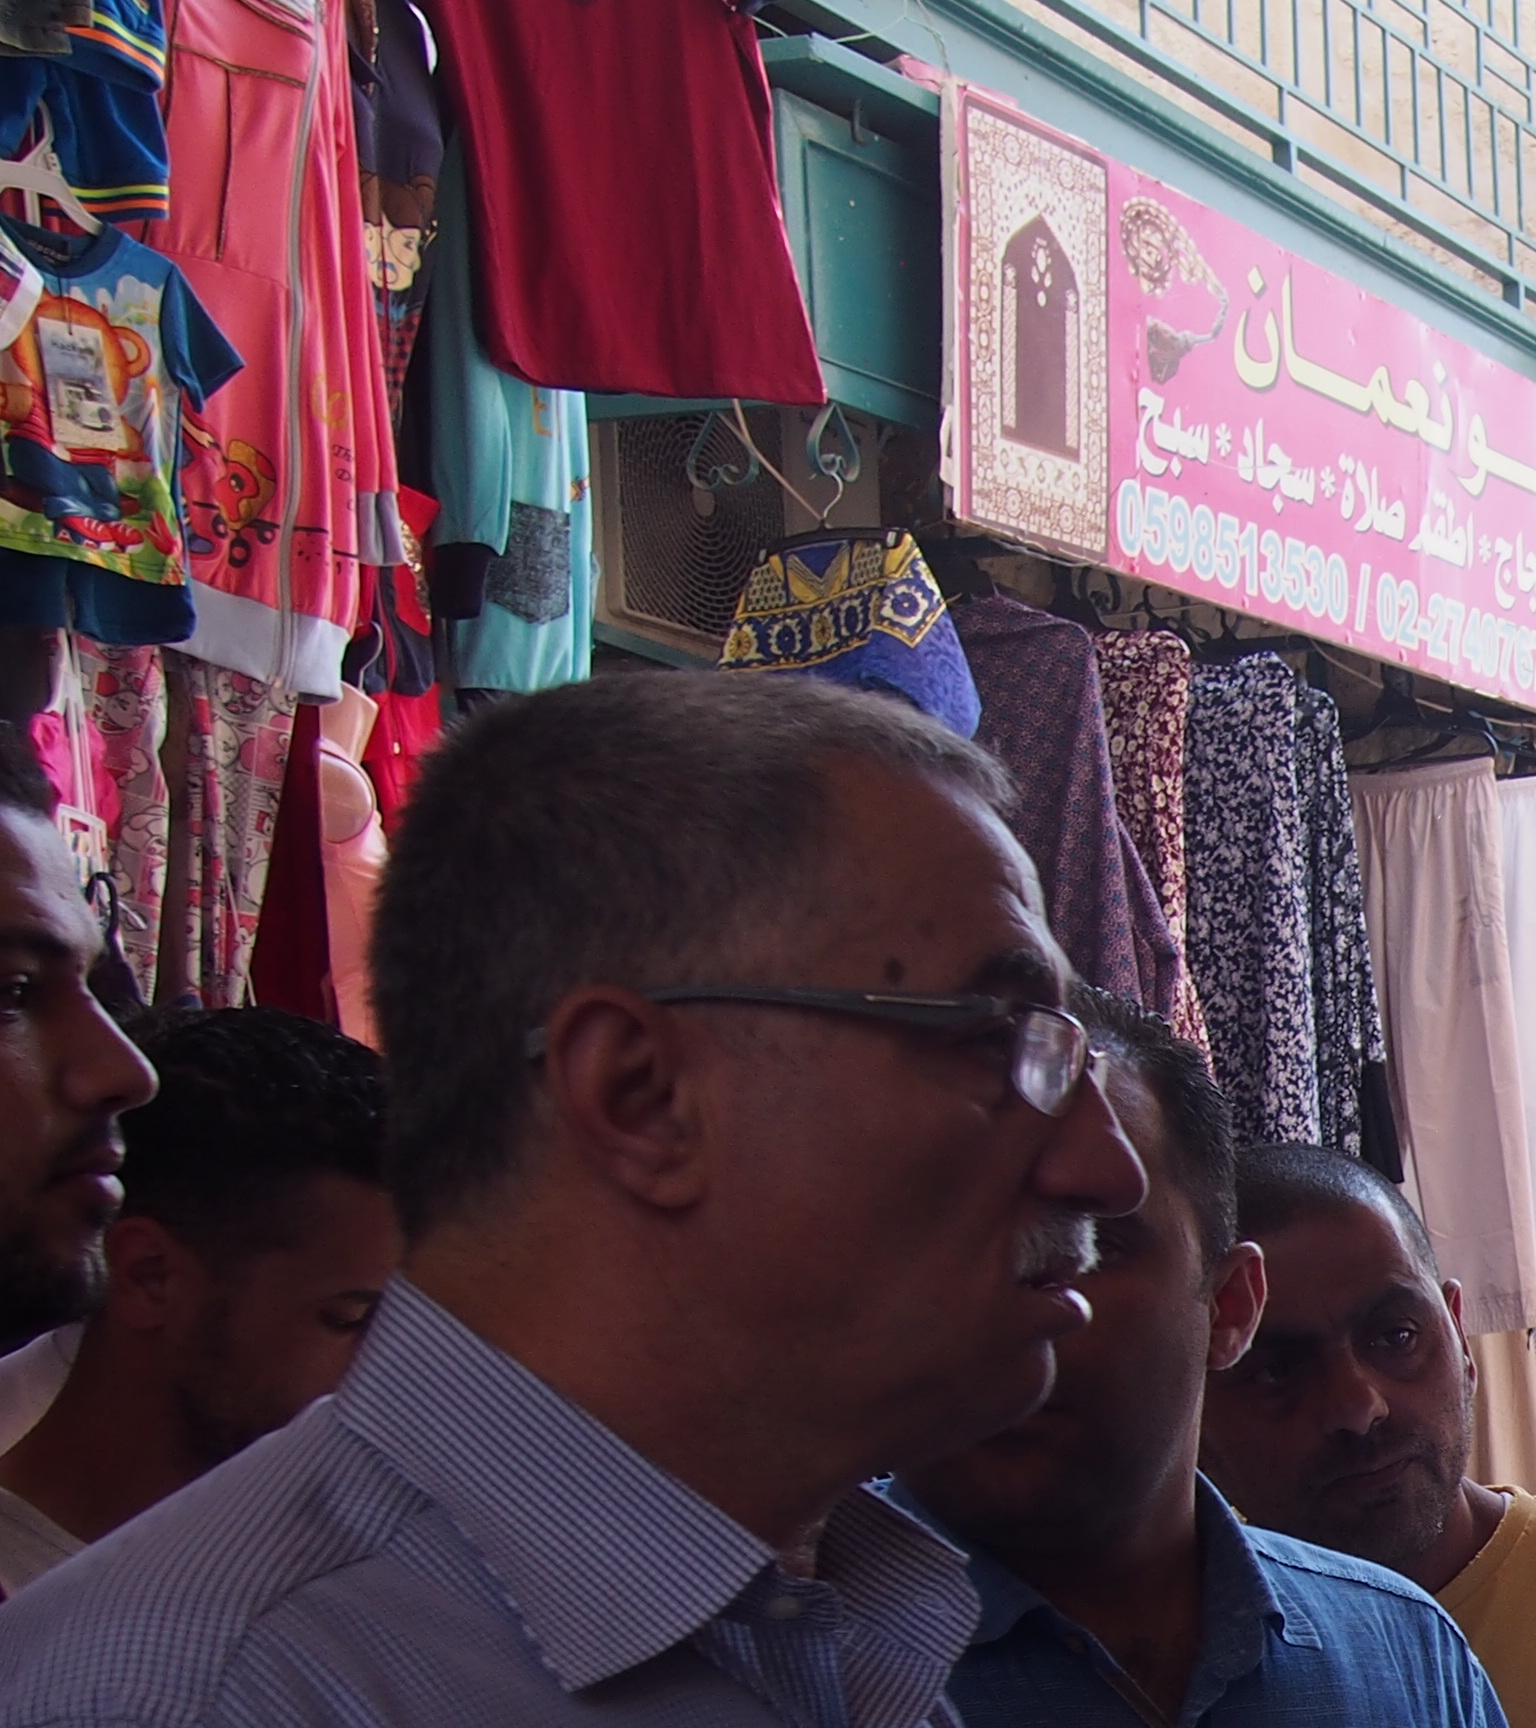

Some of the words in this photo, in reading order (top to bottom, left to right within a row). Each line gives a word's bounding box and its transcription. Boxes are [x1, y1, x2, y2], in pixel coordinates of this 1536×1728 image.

[1233, 262, 1454, 452] نعمان
[1138, 387, 1210, 479] سبح
[1238, 417, 1316, 515] سجاد
[1339, 452, 1406, 542] صلاة
[1116, 478, 1349, 625] 0598513530
